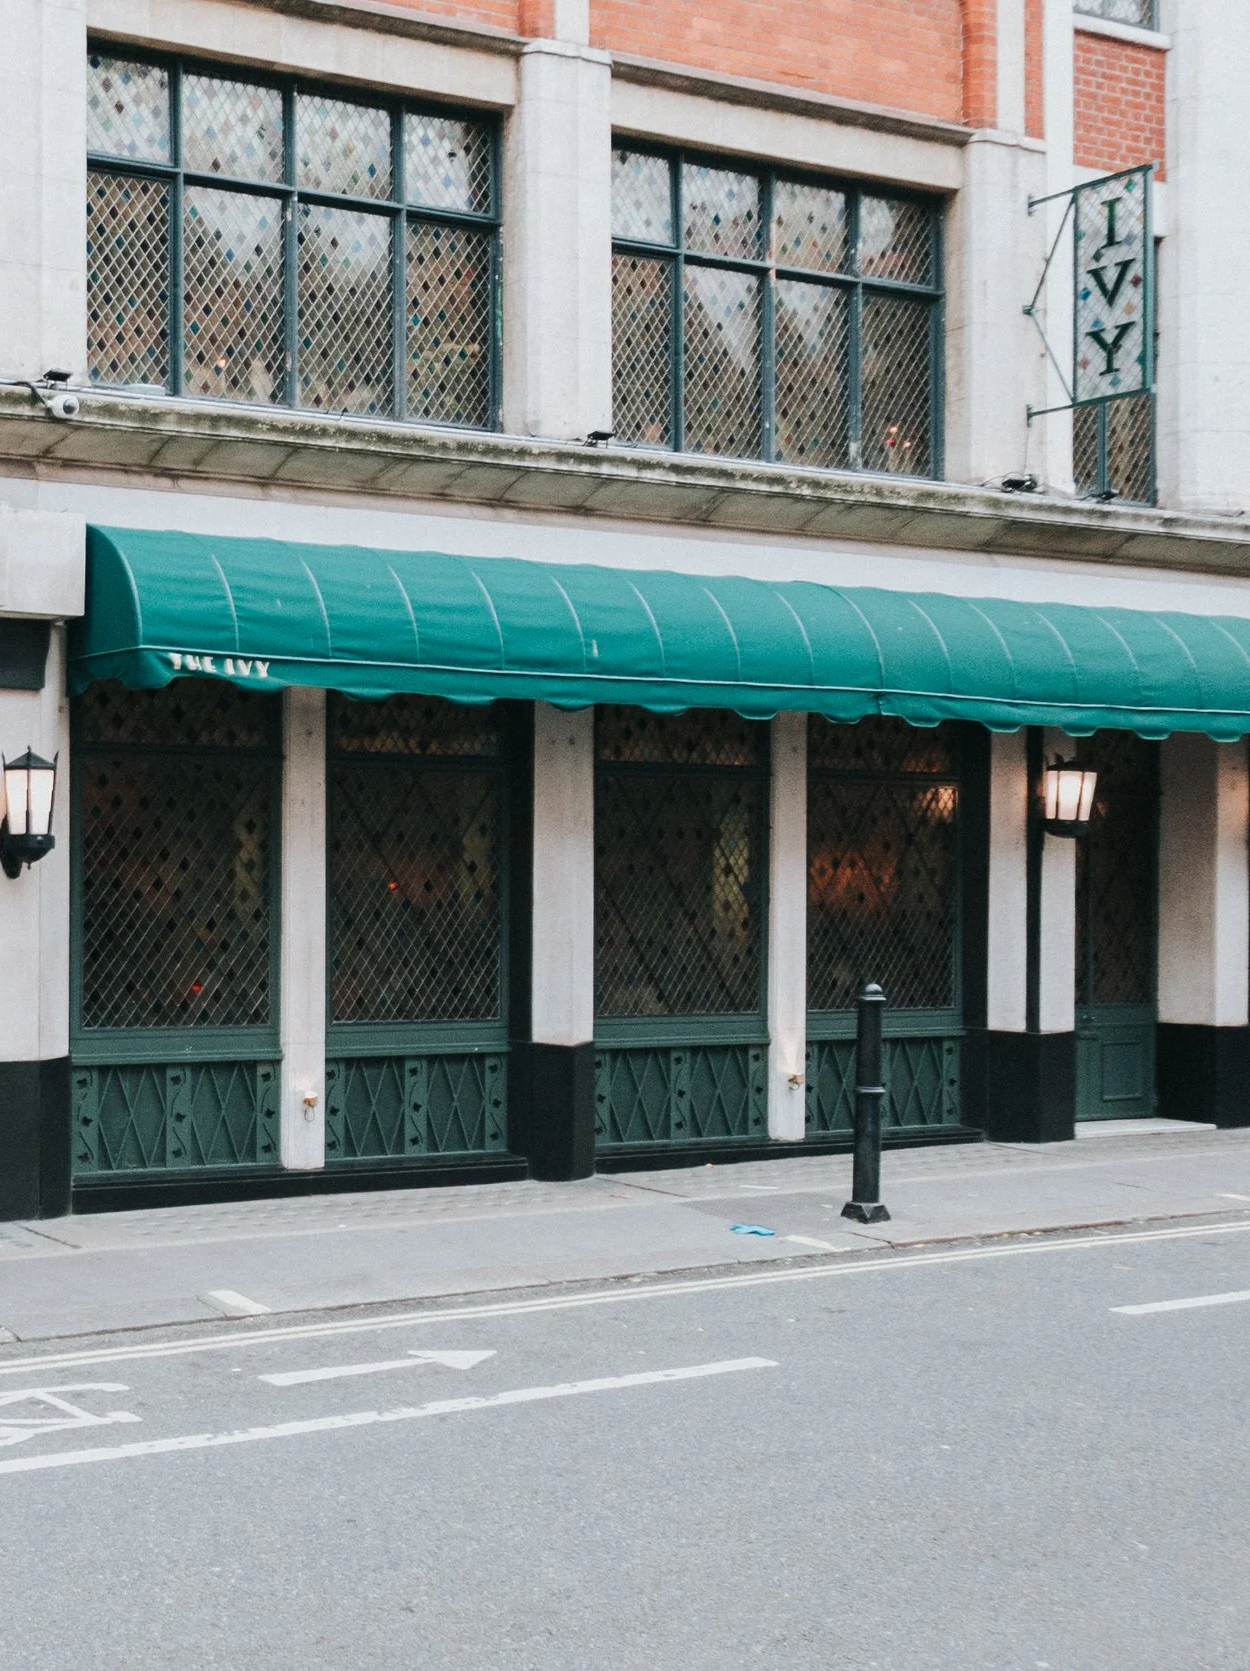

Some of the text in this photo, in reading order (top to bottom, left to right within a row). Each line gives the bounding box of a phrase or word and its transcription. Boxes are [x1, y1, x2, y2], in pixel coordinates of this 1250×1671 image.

[1086, 197, 1136, 376] IVY
[168, 652, 270, 678] THE IVY
